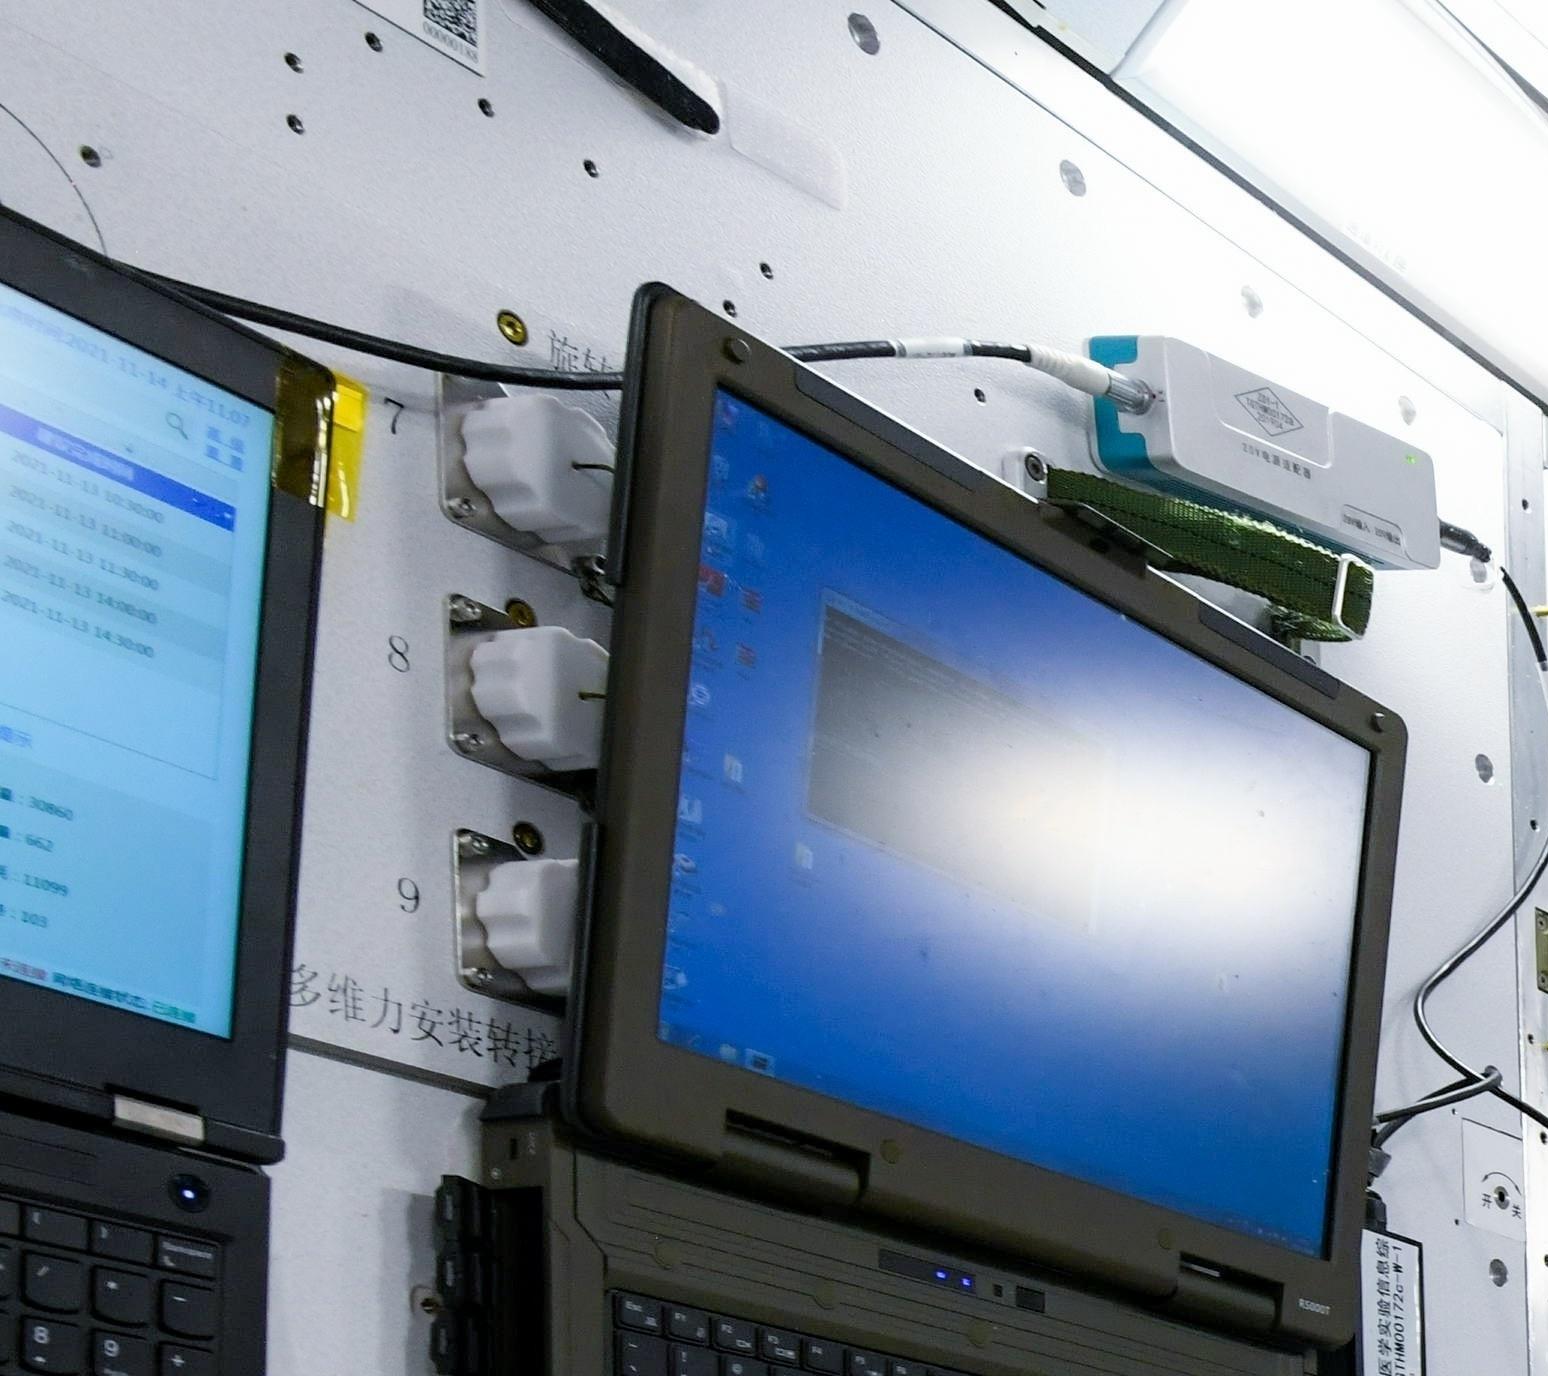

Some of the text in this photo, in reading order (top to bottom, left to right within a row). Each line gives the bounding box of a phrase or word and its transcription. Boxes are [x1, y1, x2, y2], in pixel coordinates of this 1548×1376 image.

[384, 396, 408, 436] 7
[388, 635, 410, 673] 8
[397, 877, 420, 914] 9
[33, 1326, 119, 1358] 8 9
